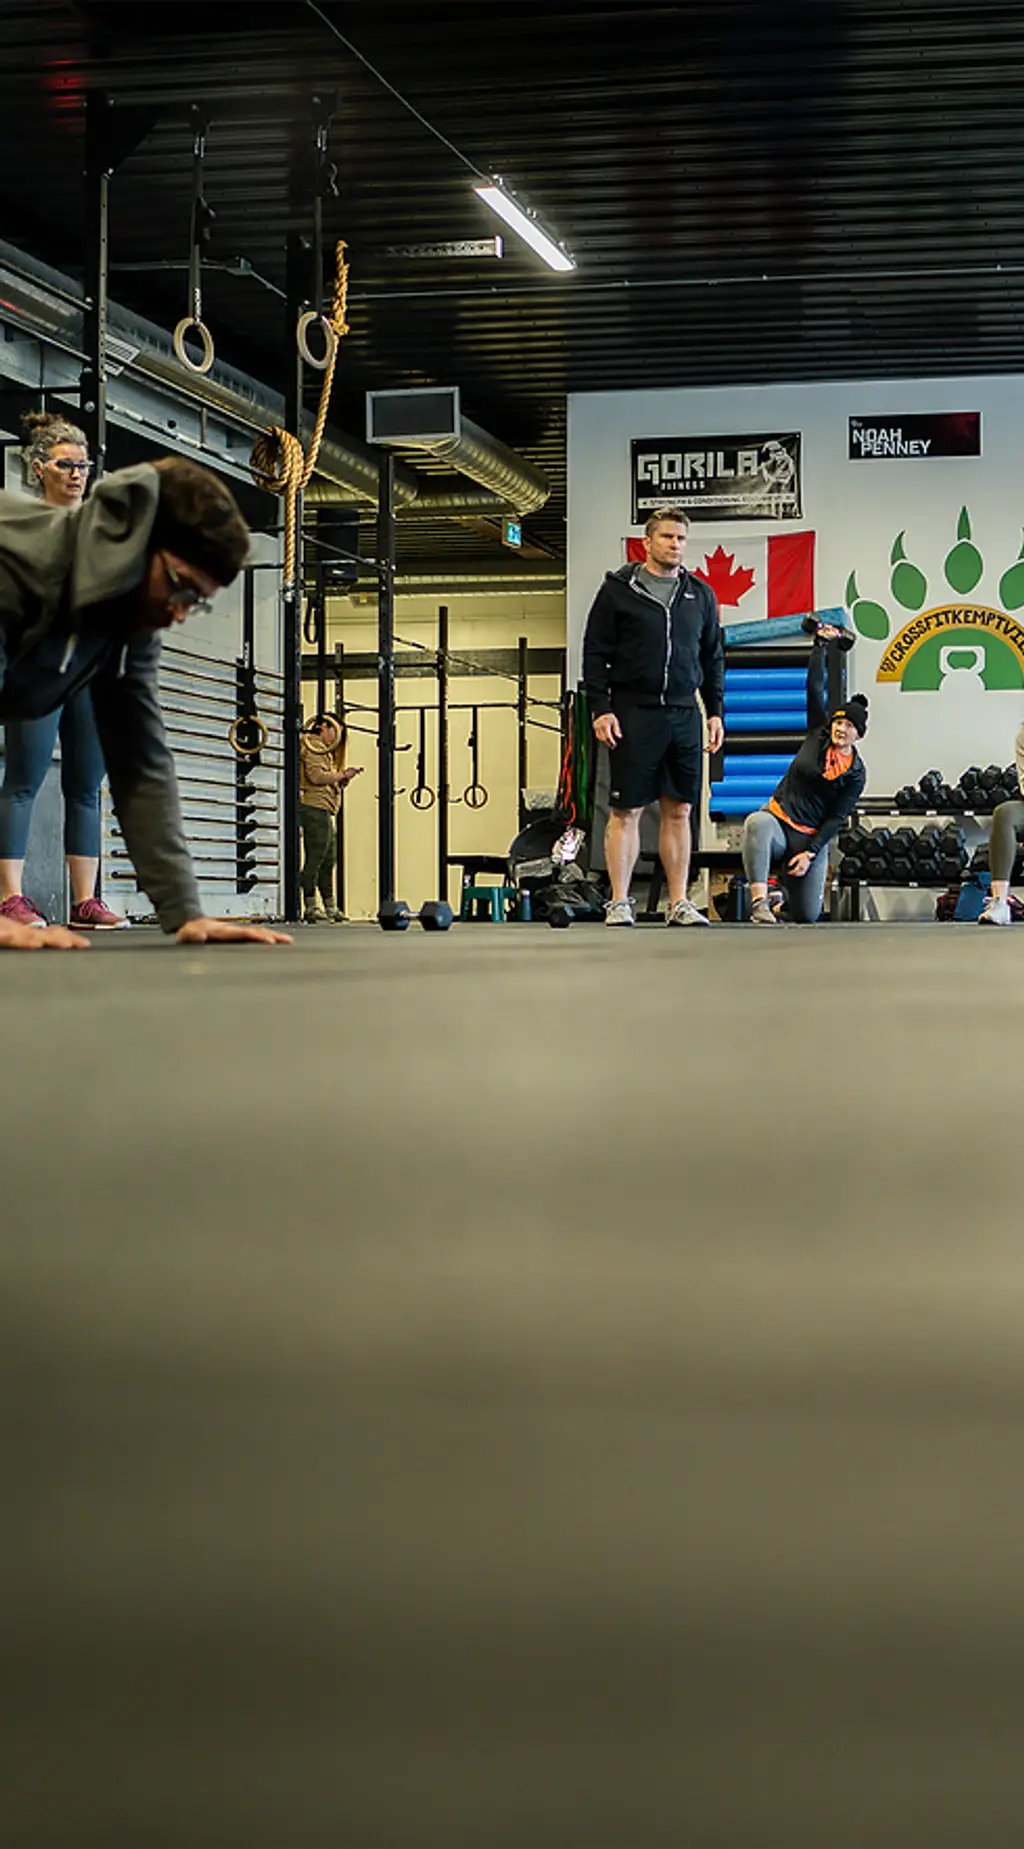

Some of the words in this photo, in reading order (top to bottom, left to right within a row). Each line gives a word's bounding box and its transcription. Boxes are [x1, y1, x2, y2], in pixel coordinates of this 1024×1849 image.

[852, 428, 902, 444] NOAH
[861, 439, 931, 456] PENNEY
[637, 450, 758, 485] GORILA
